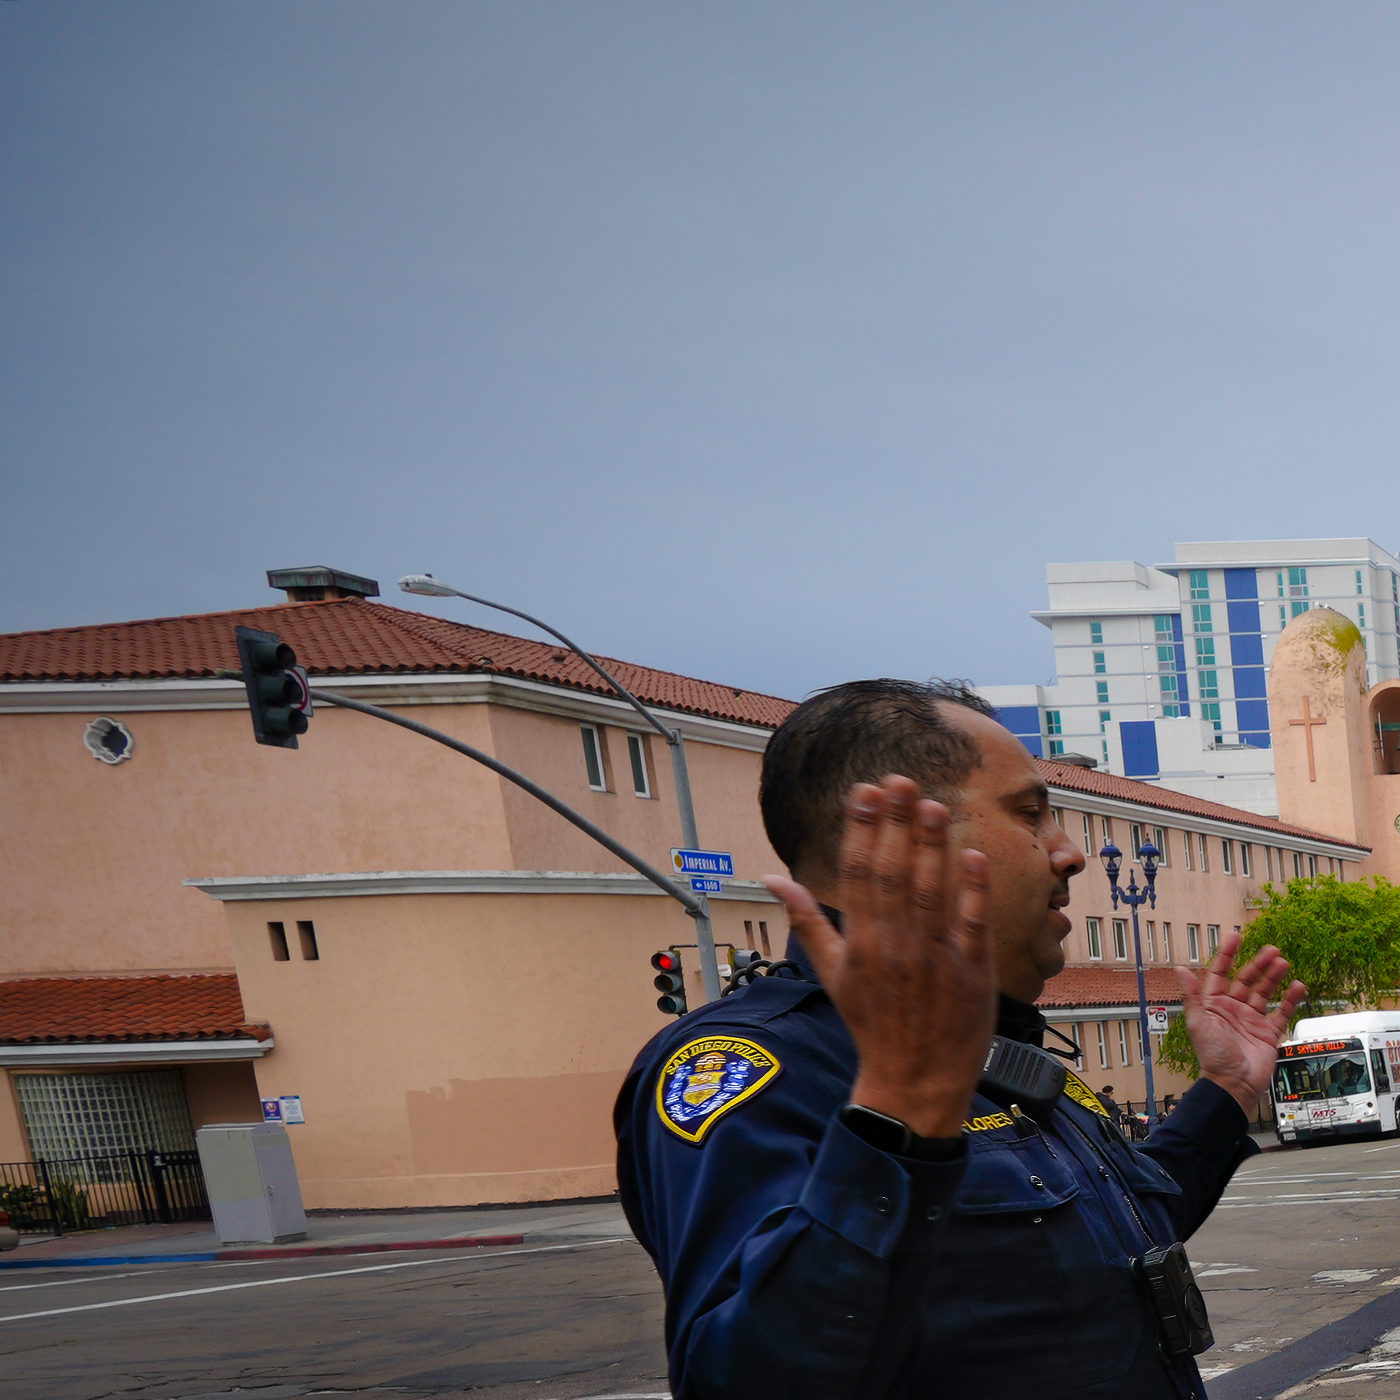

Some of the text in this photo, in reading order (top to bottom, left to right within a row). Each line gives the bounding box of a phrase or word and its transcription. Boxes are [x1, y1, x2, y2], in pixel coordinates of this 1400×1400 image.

[684, 855, 718, 871] IMPERIAL
[703, 881, 718, 890] 1600
[1285, 1042, 1346, 1056] 12 SKYLINE HILLS
[665, 1041, 772, 1075] SAN DIEGO POLICE
[1312, 1108, 1336, 1118] MTS
